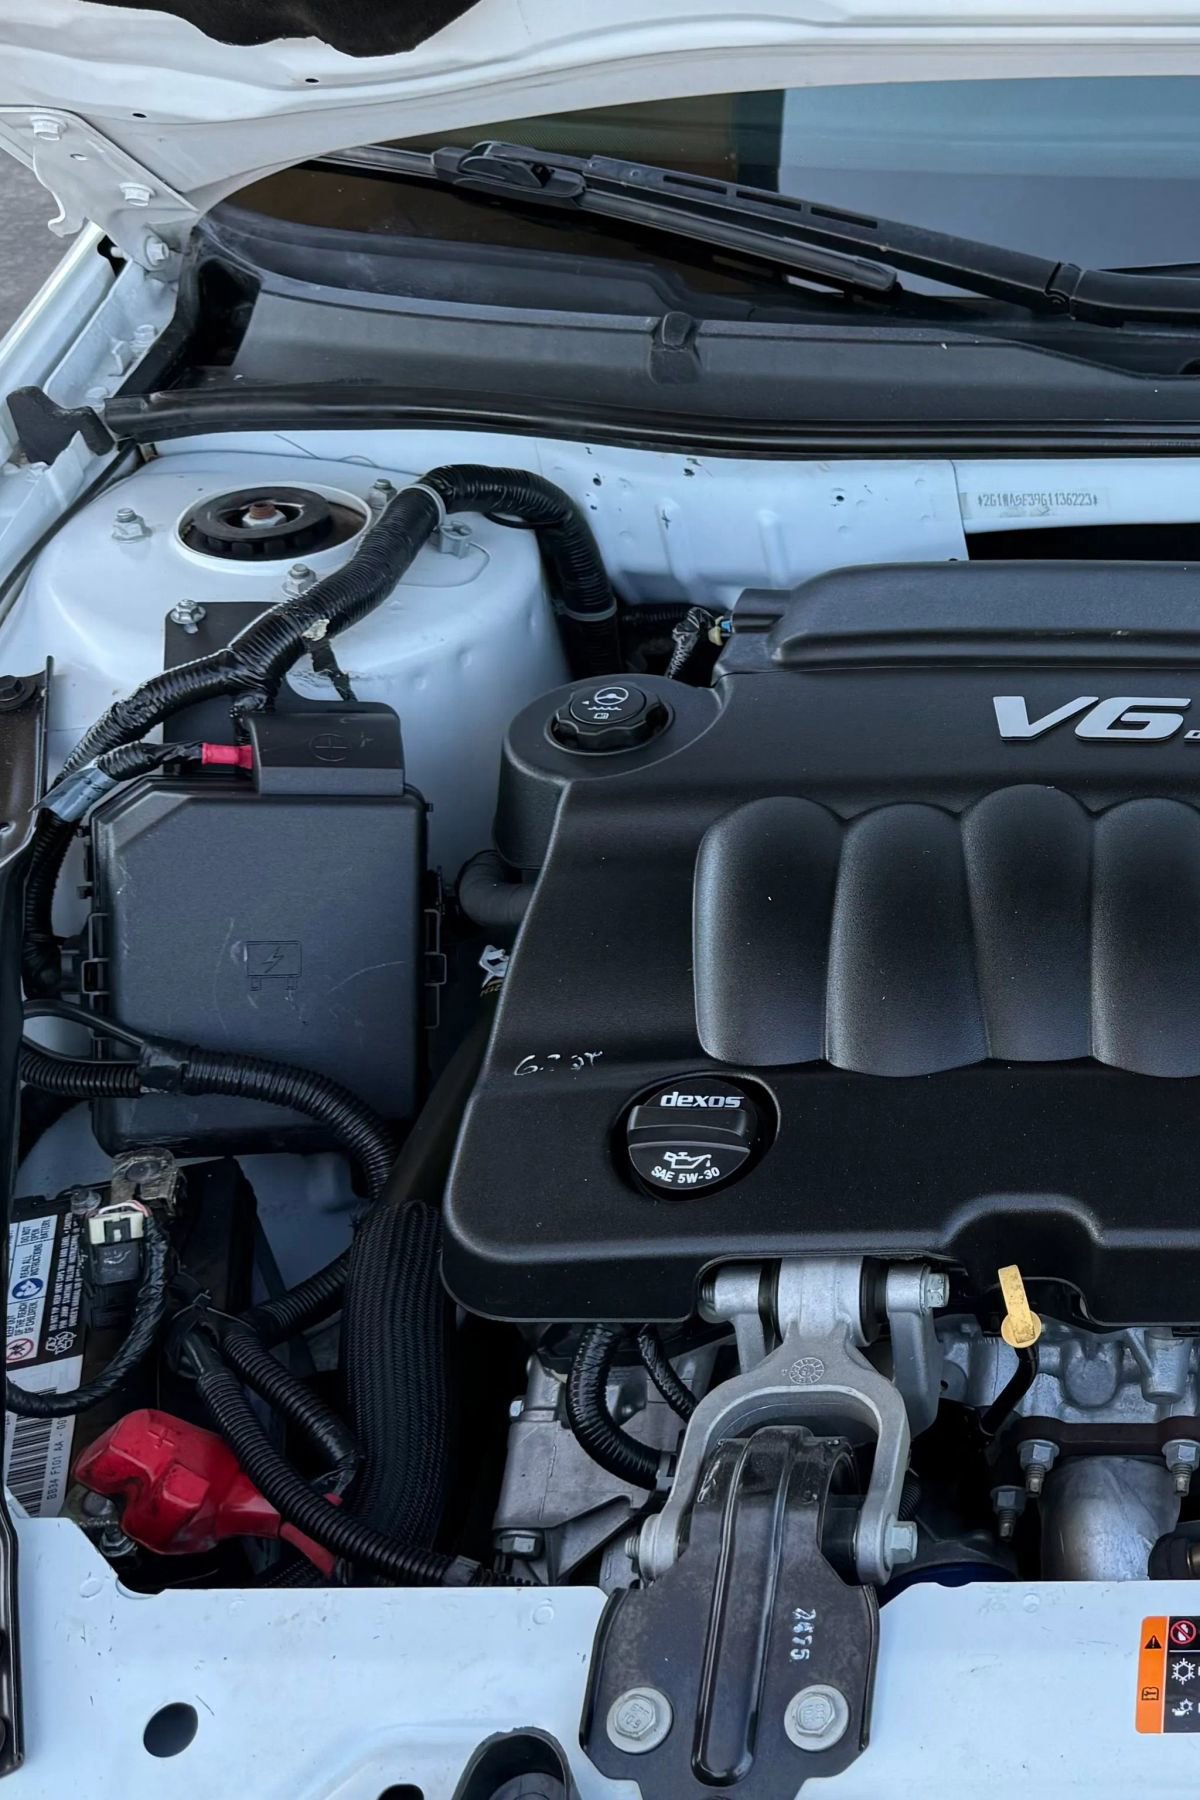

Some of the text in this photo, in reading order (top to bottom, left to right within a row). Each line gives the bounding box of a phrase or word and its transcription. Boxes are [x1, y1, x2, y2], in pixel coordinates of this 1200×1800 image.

[993, 696, 1191, 740] V6
[660, 1091, 744, 1108] dexos
[651, 1166, 720, 1184] SAE 5W-30
